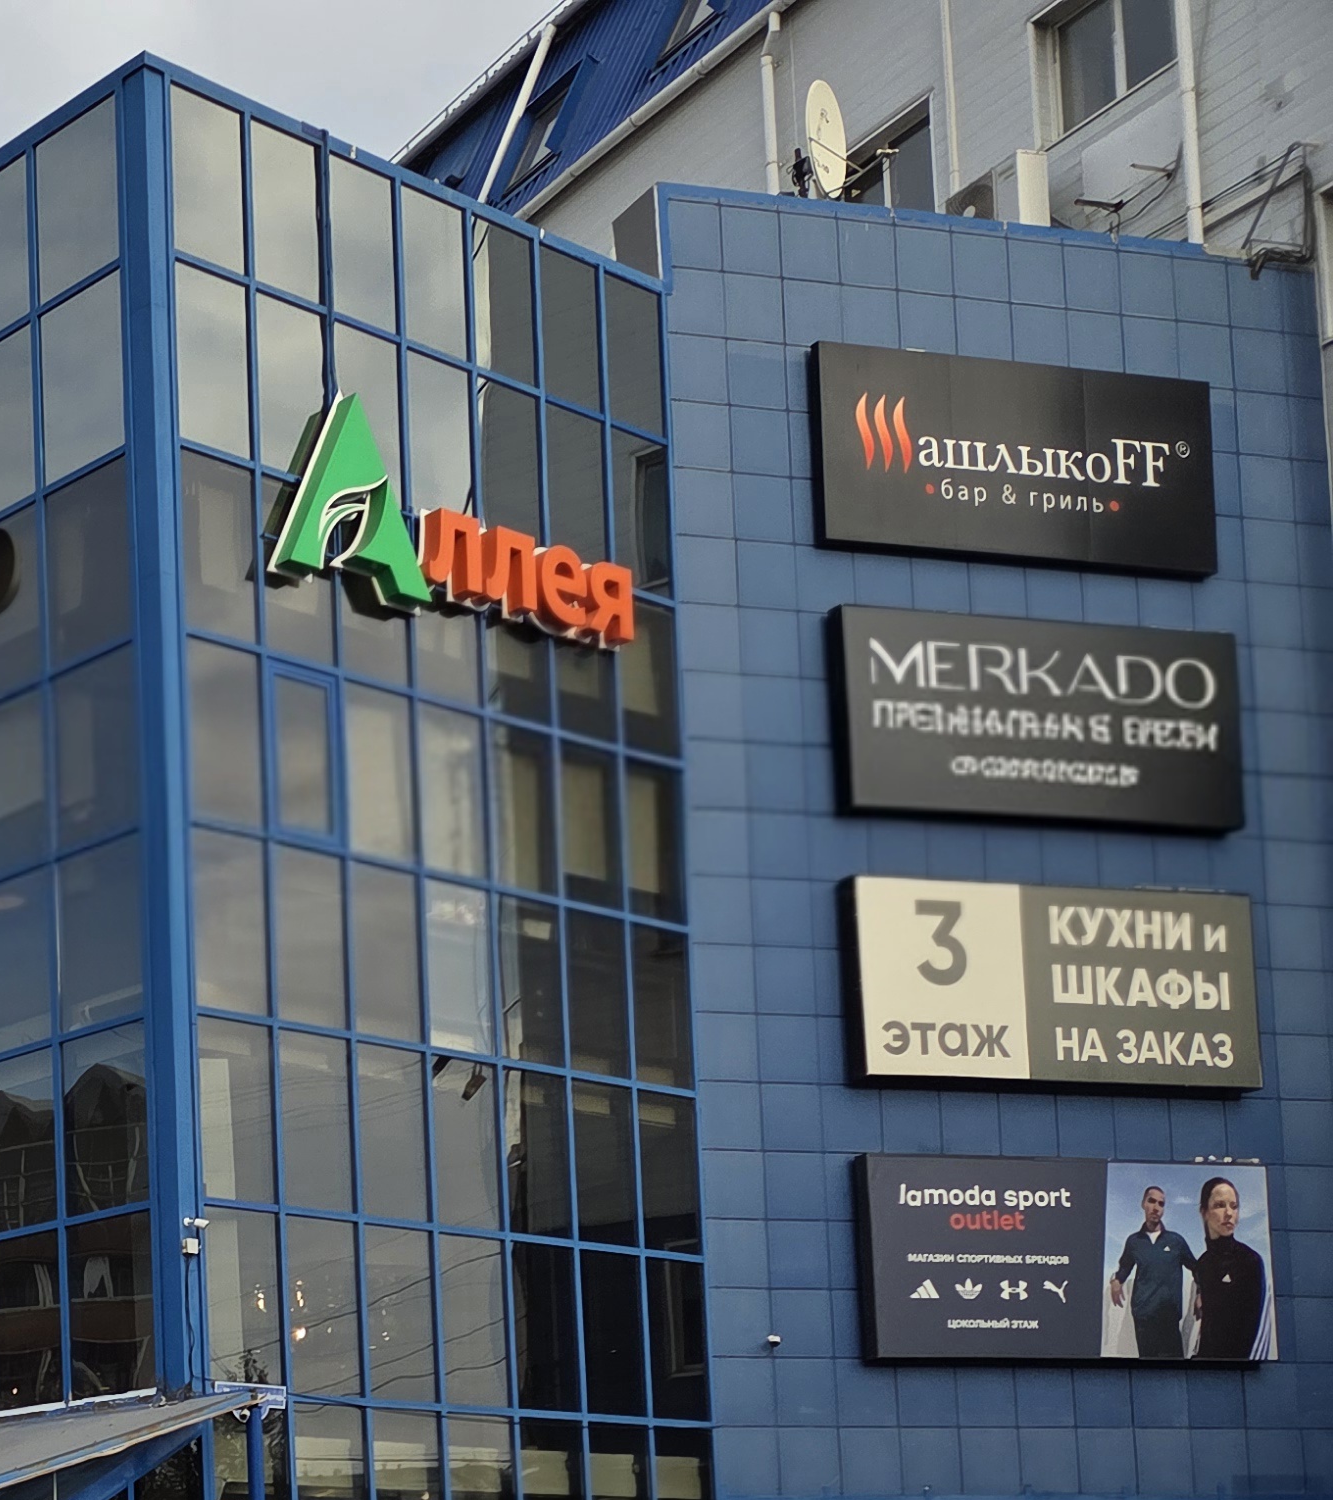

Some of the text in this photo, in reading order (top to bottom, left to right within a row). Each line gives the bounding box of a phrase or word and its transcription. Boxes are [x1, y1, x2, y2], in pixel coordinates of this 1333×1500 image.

[941, 480, 1105, 514] бар & гриль
[267, 389, 634, 655] Аллея
[869, 637, 1217, 709] MERKADO
[914, 899, 967, 986] 3
[1048, 905, 1191, 951] КУХНИ
[1051, 963, 1231, 1011] ШКАФЫ
[881, 1019, 1012, 1060] этаж
[1055, 1026, 1234, 1069] НА ЗАКАЗ
[899, 1183, 1071, 1211] lamoda sport
[949, 1210, 1026, 1231] outlet
[907, 1253, 954, 1263] МАГАЗИН
[947, 1317, 1039, 1329] ЦОКОЛЬНЫЙ ЭТАЖ
